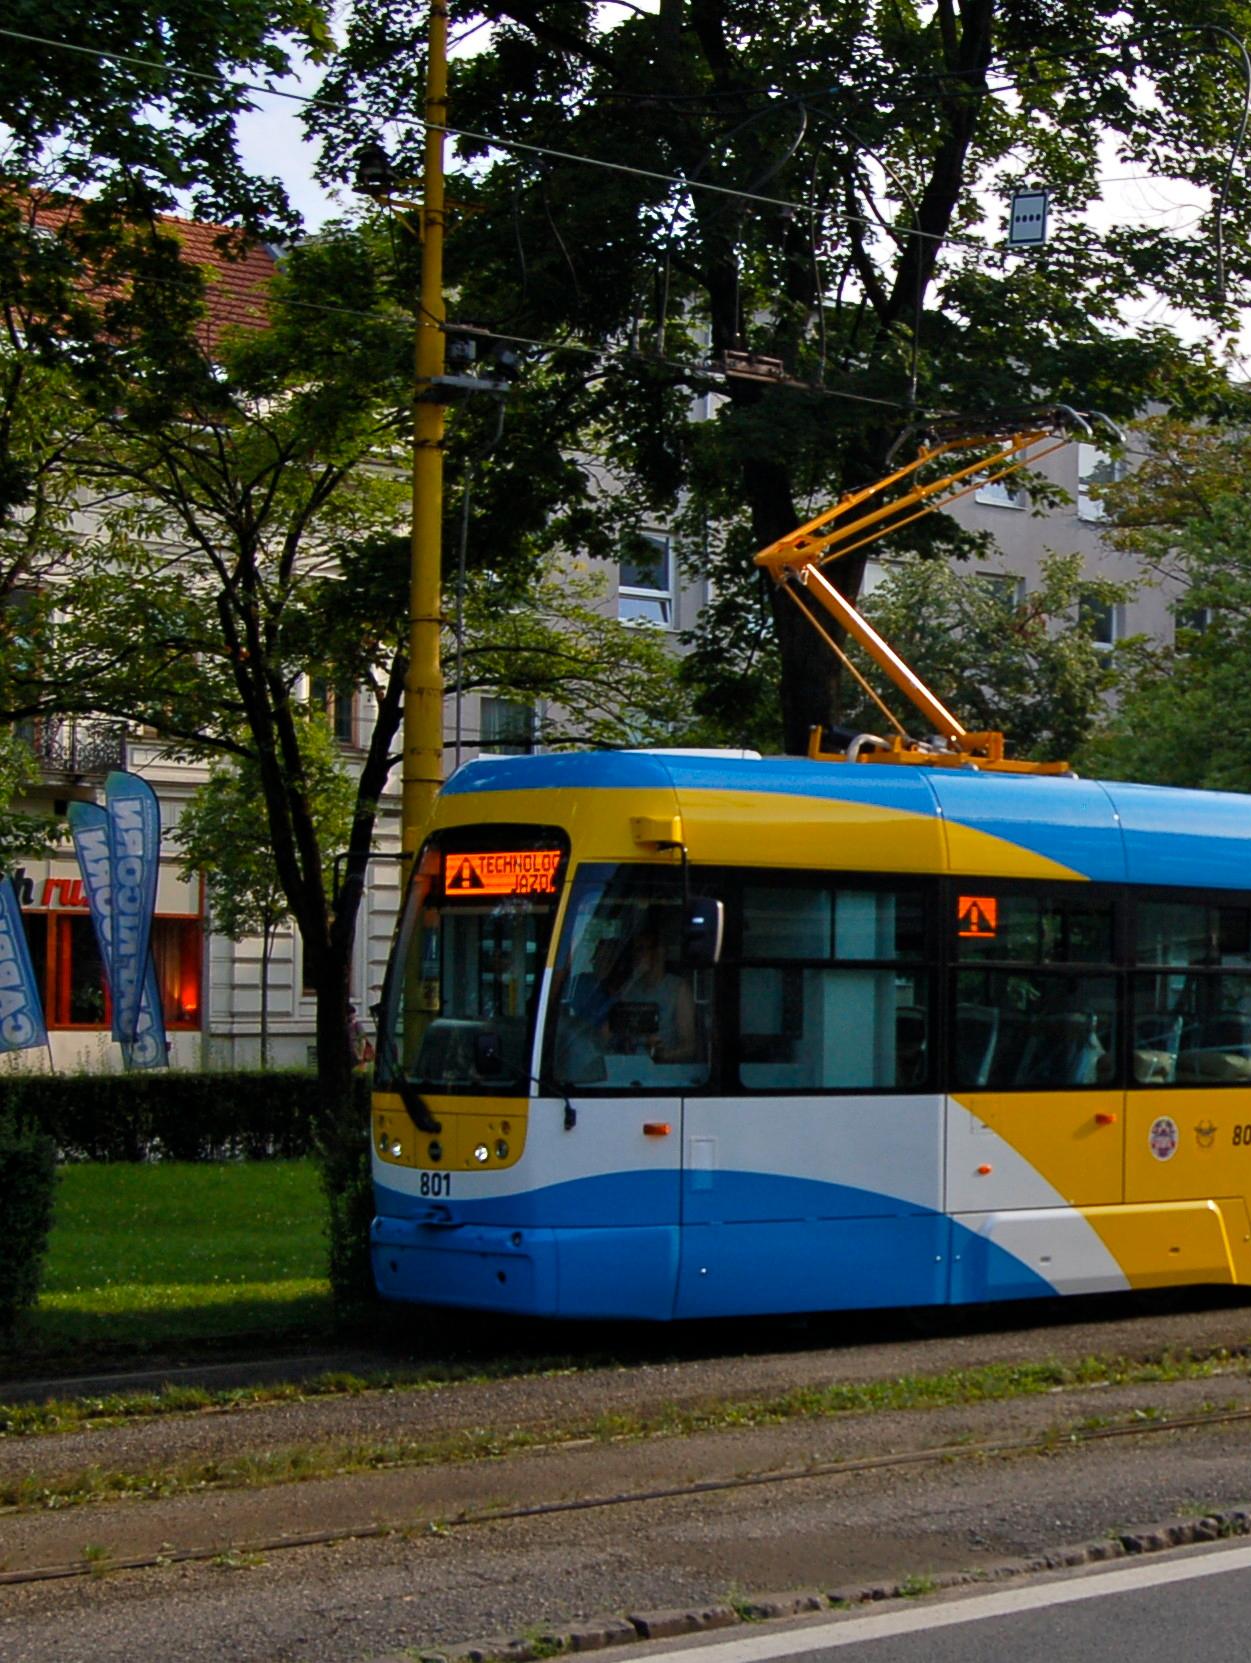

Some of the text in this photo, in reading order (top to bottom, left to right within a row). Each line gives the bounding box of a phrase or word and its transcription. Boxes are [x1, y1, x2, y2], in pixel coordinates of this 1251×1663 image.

[41, 878, 89, 906] ru
[513, 873, 556, 893] JAZD
[420, 1171, 451, 1197] 801
